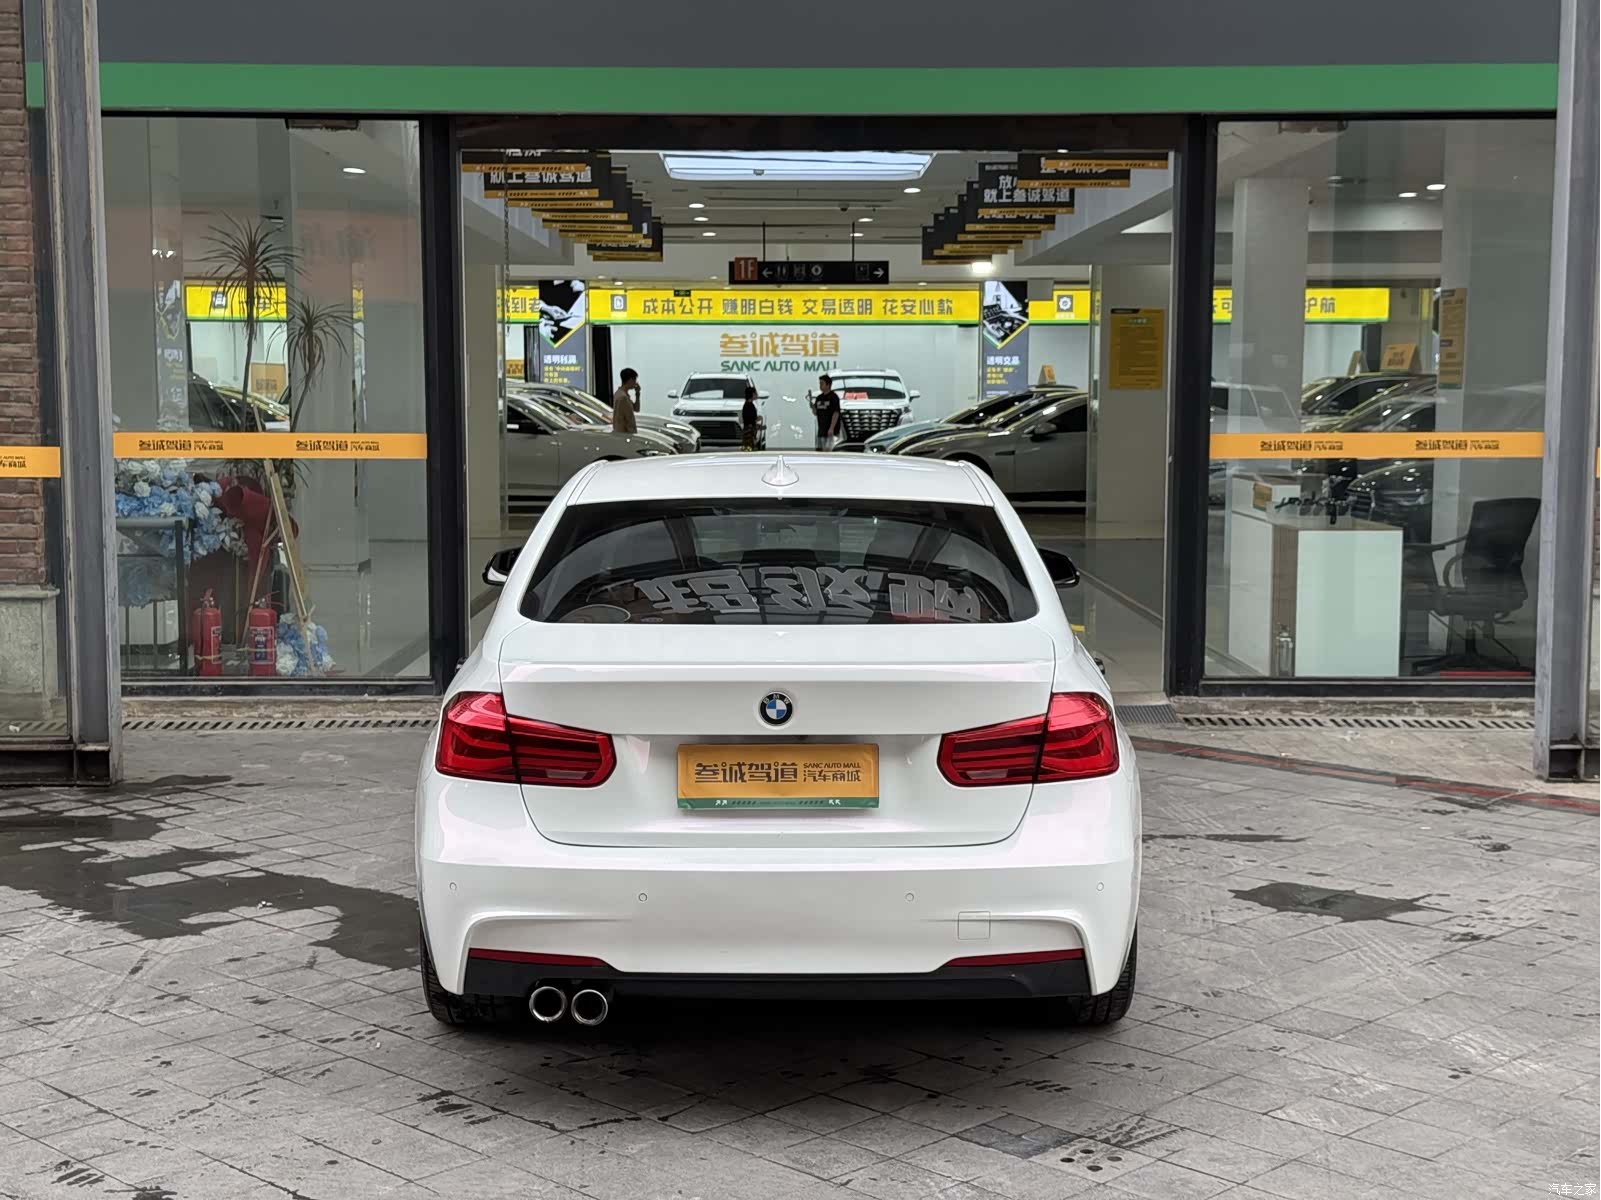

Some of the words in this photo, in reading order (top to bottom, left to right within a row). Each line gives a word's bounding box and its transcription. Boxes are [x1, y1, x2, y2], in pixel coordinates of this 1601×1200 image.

[739, 260, 756, 279] 1F
[643, 298, 713, 315] 成本公开
[722, 298, 794, 315] 赚明白钱
[802, 298, 873, 315] 交易透明
[882, 298, 953, 315] 花安心款
[720, 332, 840, 357] 叁诚驾道
[721, 360, 760, 372] SANC
[763, 360, 800, 372] AUTO
[695, 761, 798, 783] 叁诚驾道
[803, 769, 861, 782] 汽车商城
